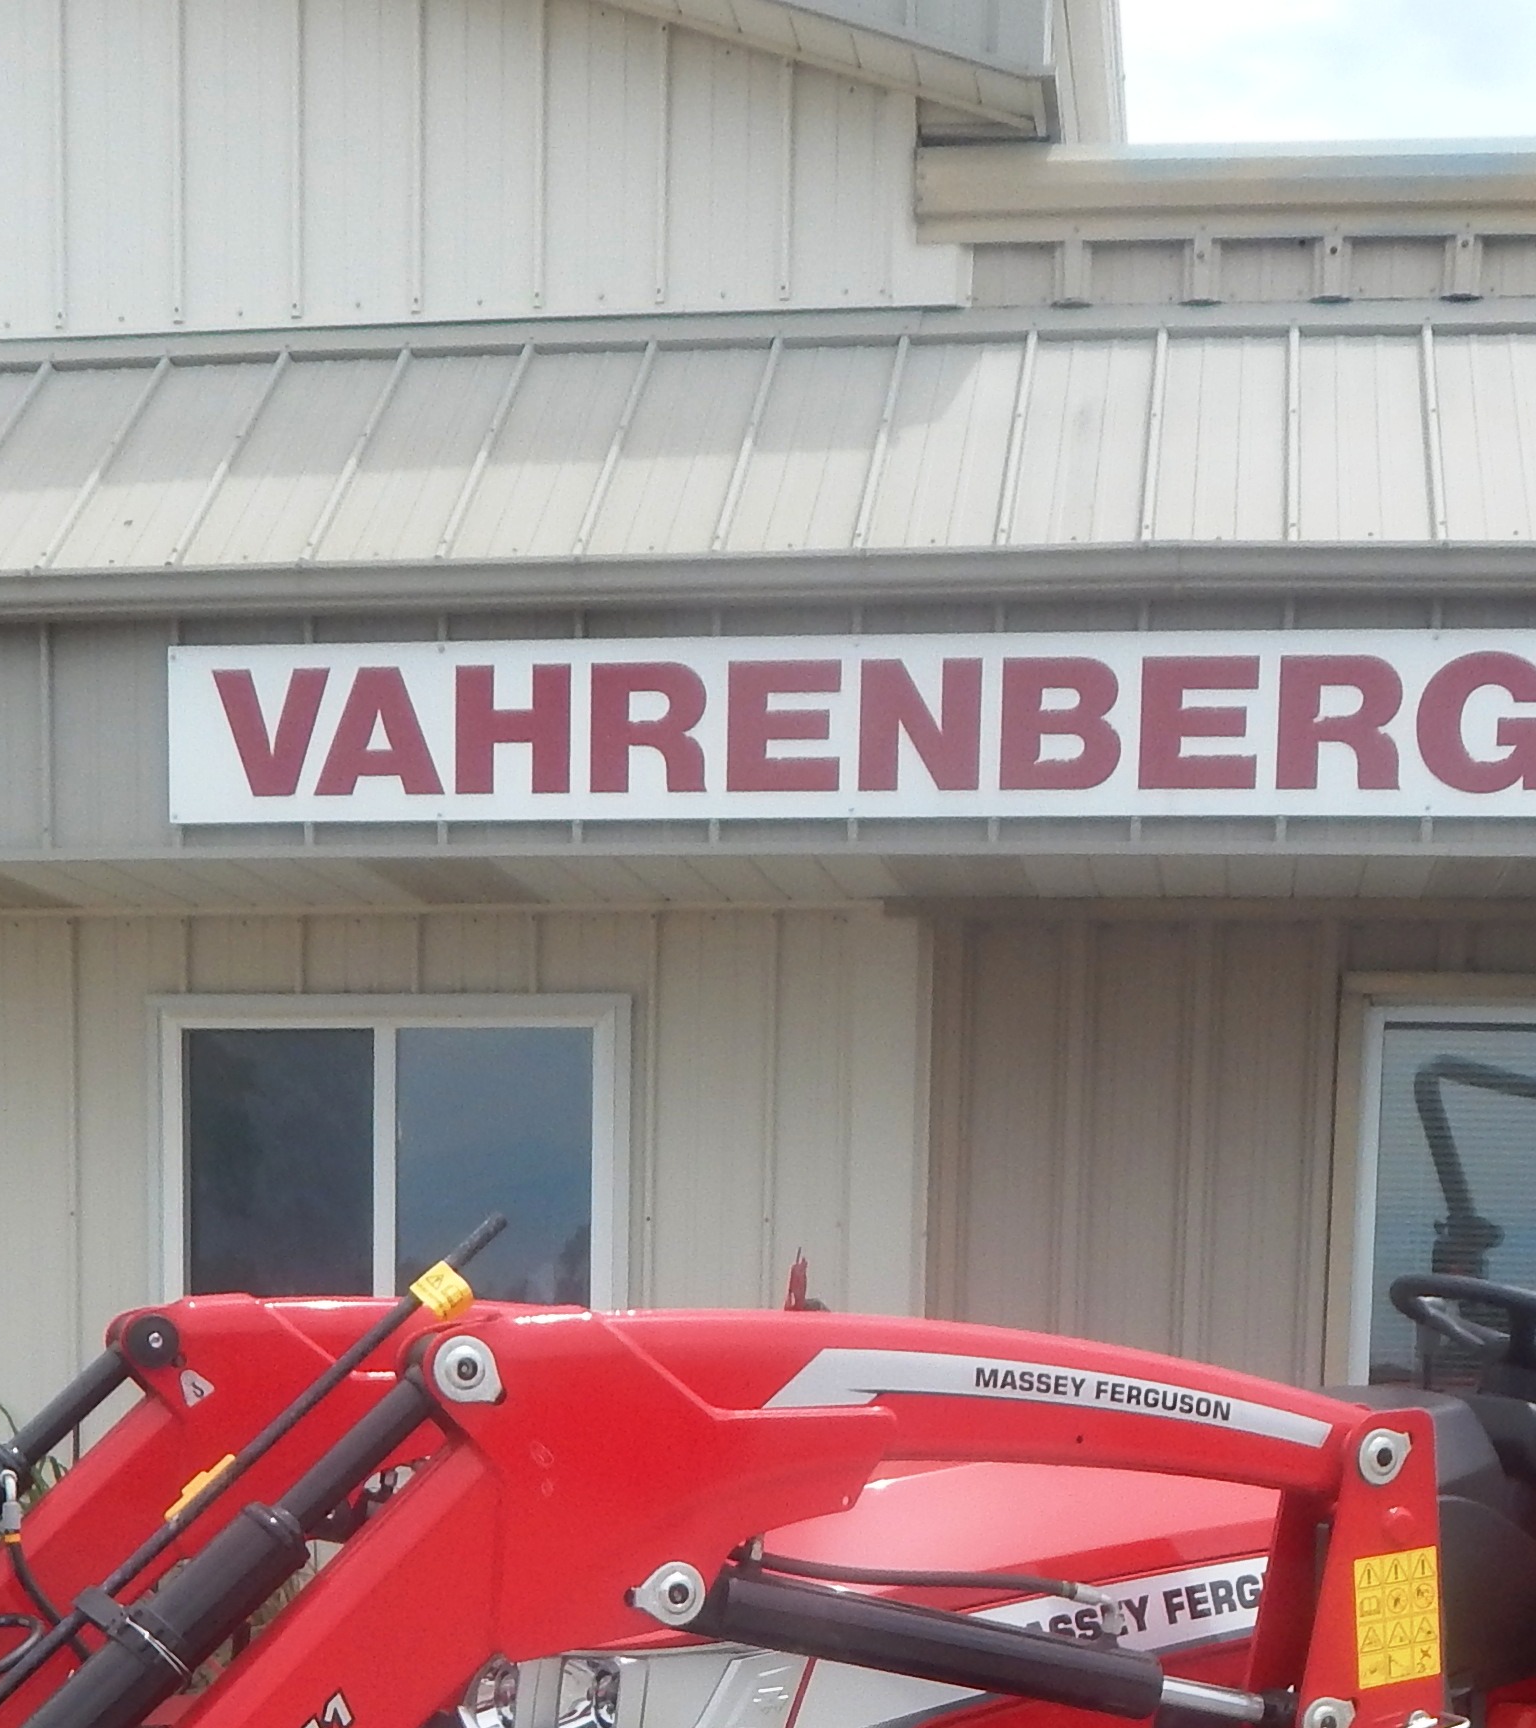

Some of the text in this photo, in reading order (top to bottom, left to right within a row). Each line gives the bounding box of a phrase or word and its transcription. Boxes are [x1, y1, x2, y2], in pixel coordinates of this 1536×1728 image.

[974, 1365, 1232, 1422] MASSEY FERGUSON
[1162, 1573, 1268, 1625] FERG
